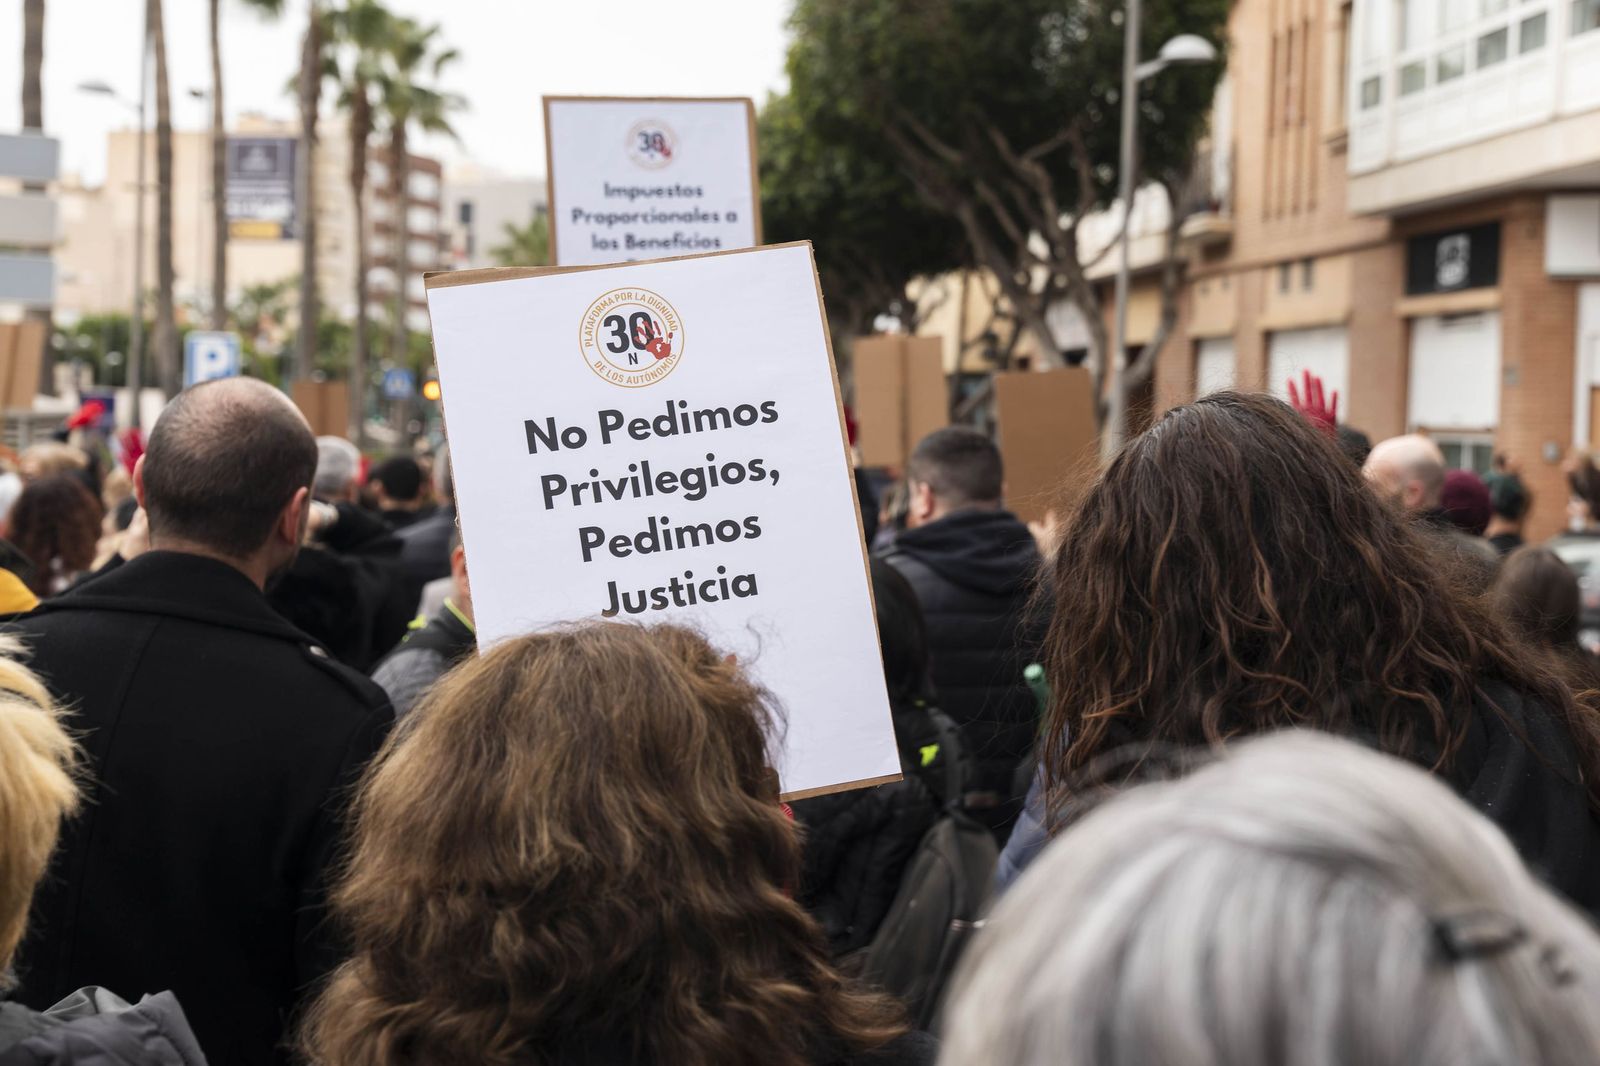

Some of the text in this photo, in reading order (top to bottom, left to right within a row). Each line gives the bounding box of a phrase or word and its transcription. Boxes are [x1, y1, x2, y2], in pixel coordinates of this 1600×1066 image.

[603, 182, 703, 202] Impuestos
[571, 208, 738, 228] Proporcionales a
[591, 230, 721, 250] los Beneficios
[584, 292, 678, 348] PLATAFORMA POR LA DIGNIDAD
[603, 311, 655, 353] 30
[594, 360, 607, 372] DE
[606, 370, 624, 384] LOS
[628, 352, 639, 366] N
[524, 399, 779, 455] No Pedimos
[540, 452, 780, 511] Privilegios,
[578, 515, 762, 563] Pedimos
[600, 565, 759, 618] Justicia
